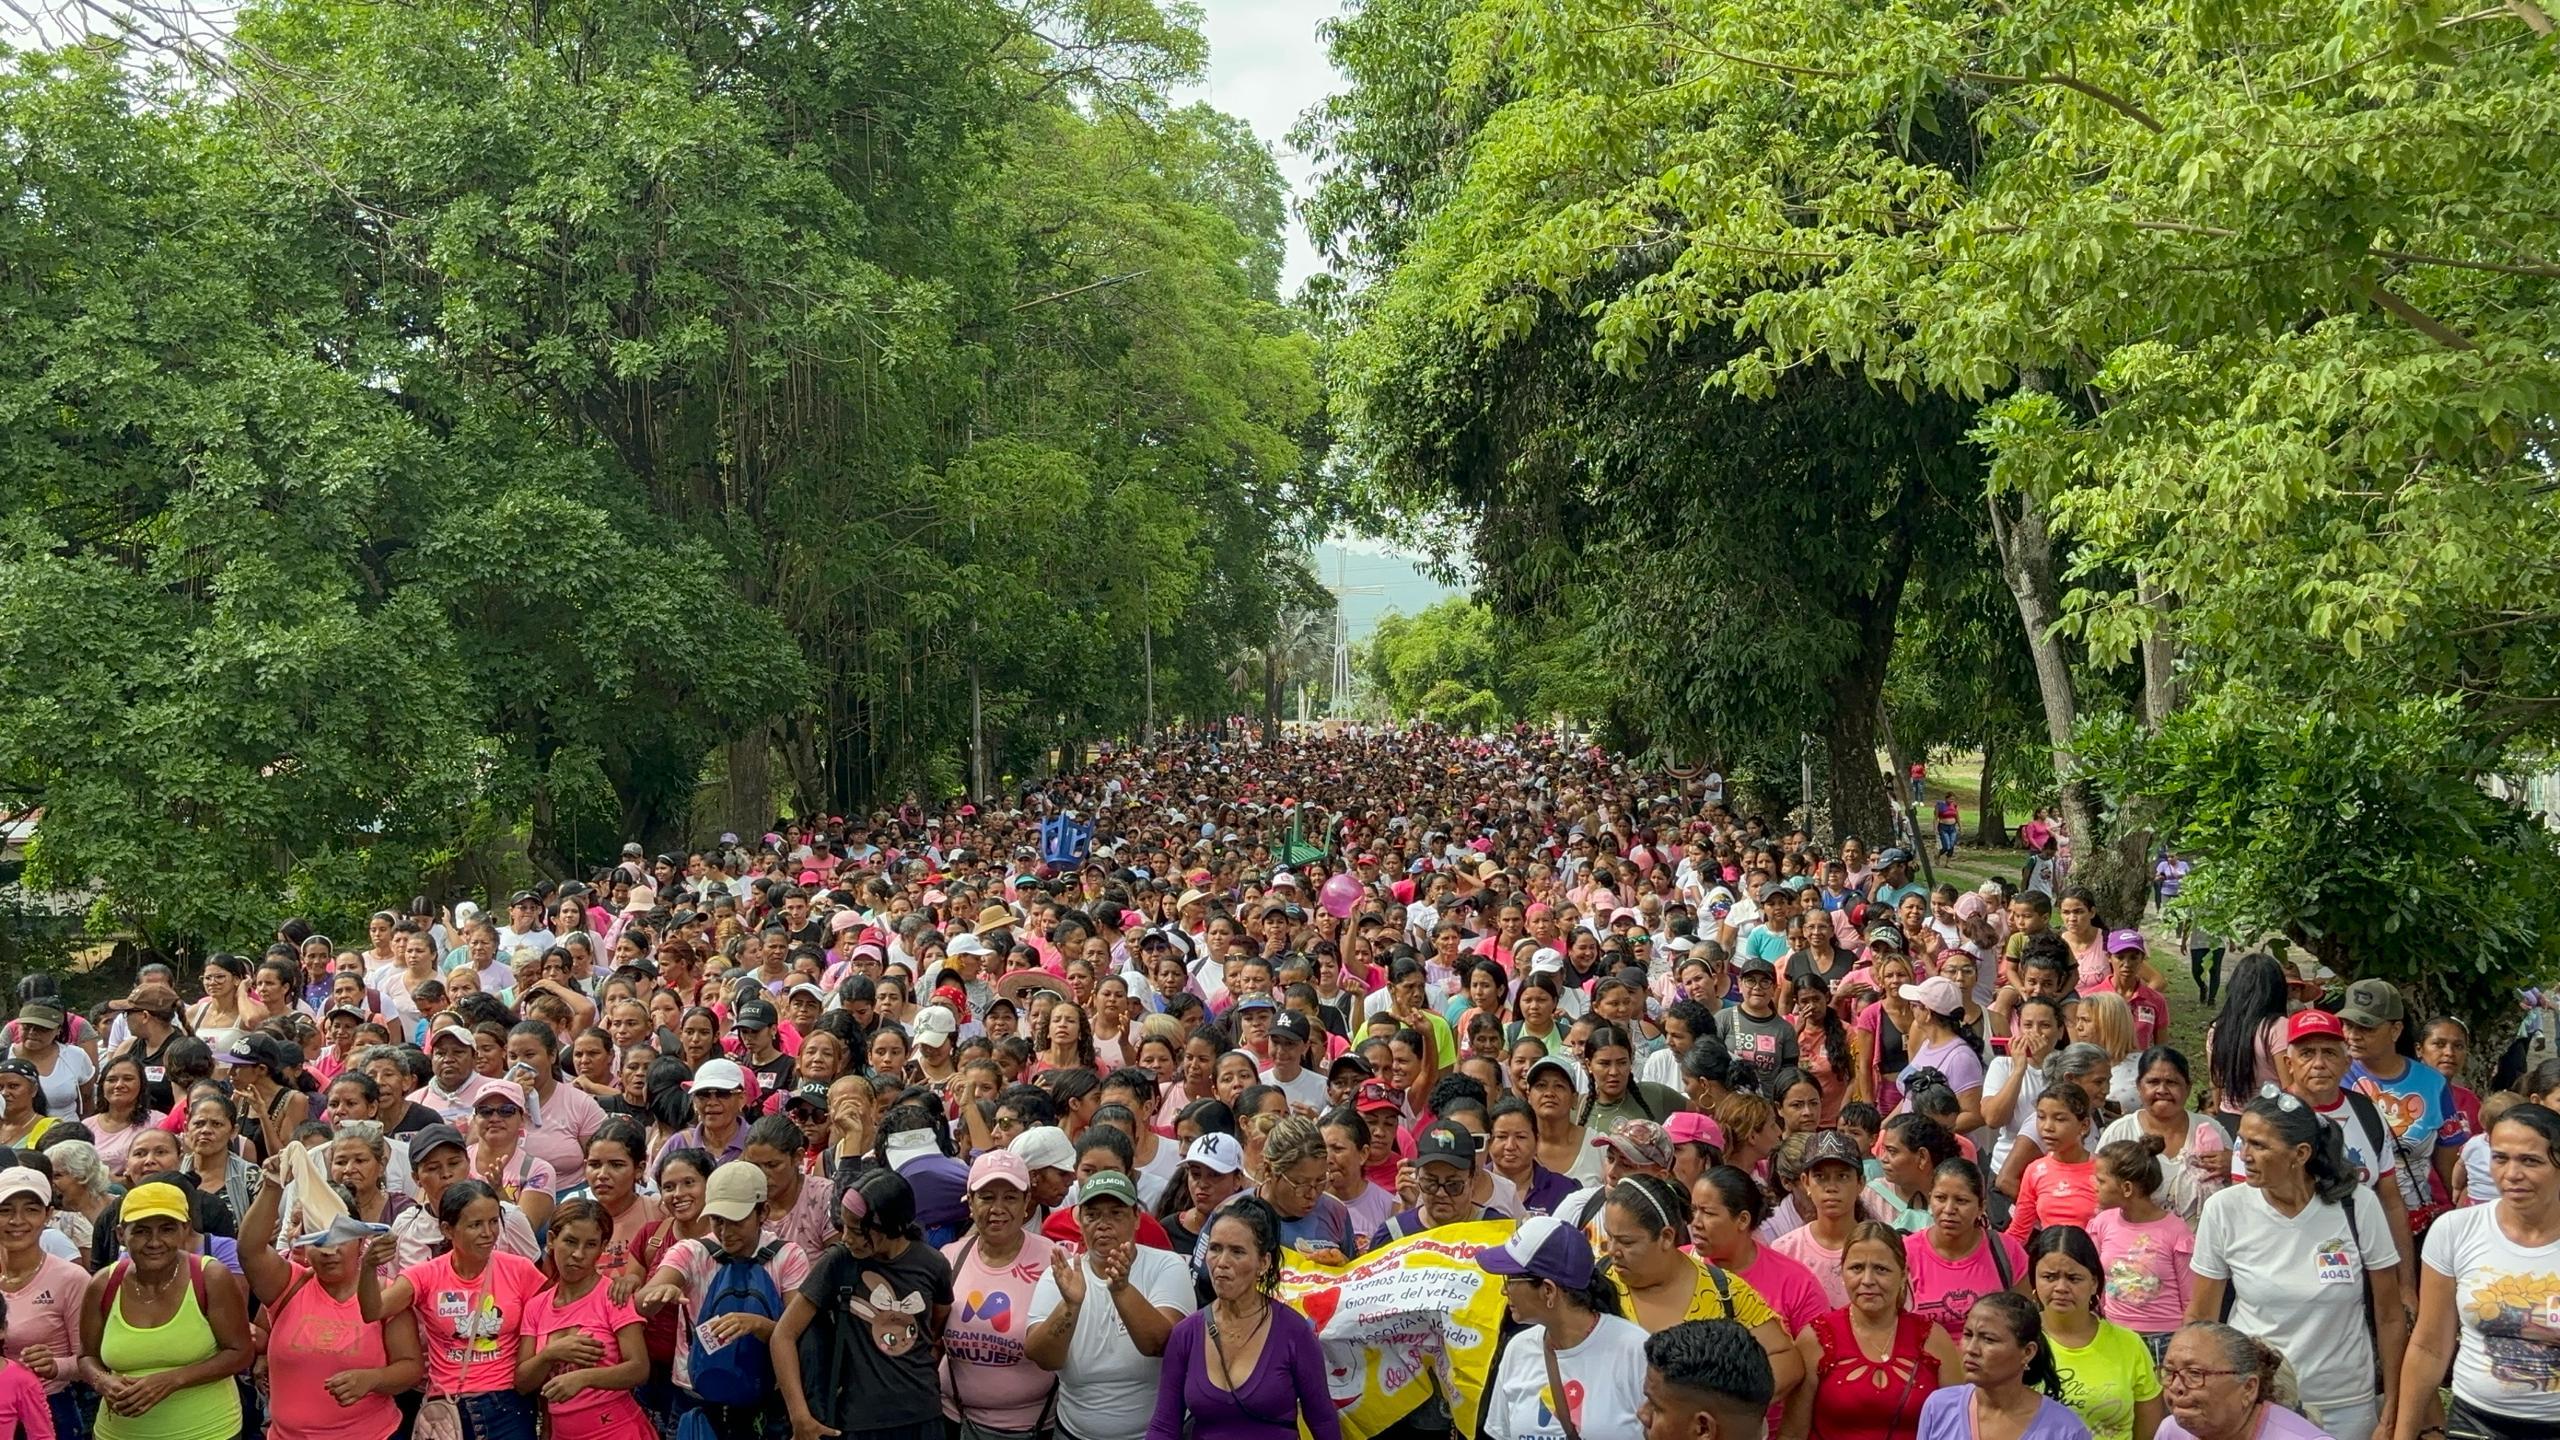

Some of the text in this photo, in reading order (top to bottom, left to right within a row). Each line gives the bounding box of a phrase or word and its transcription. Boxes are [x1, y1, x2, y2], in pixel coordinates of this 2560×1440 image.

[803, 1083, 829, 1095] OR
[1197, 1134, 1219, 1154] NY
[1095, 1178, 1126, 1187] ELMOR
[1398, 1271, 1418, 1284] las
[1421, 1269, 1458, 1285] hijas
[1460, 1272, 1480, 1287] de
[2320, 1269, 2351, 1280] 4043
[1400, 1286, 1424, 1300] del
[1426, 1286, 1468, 1301] verbo
[440, 1306, 466, 1316] 0445
[1435, 1300, 1450, 1315] la
[700, 1325, 717, 1350] 0623
[946, 1329, 1025, 1351] GRAN MISIÓN
[1441, 1326, 1478, 1346] ida"
[446, 1348, 503, 1363] #SLFIE
[948, 1347, 1021, 1364] MUJER
